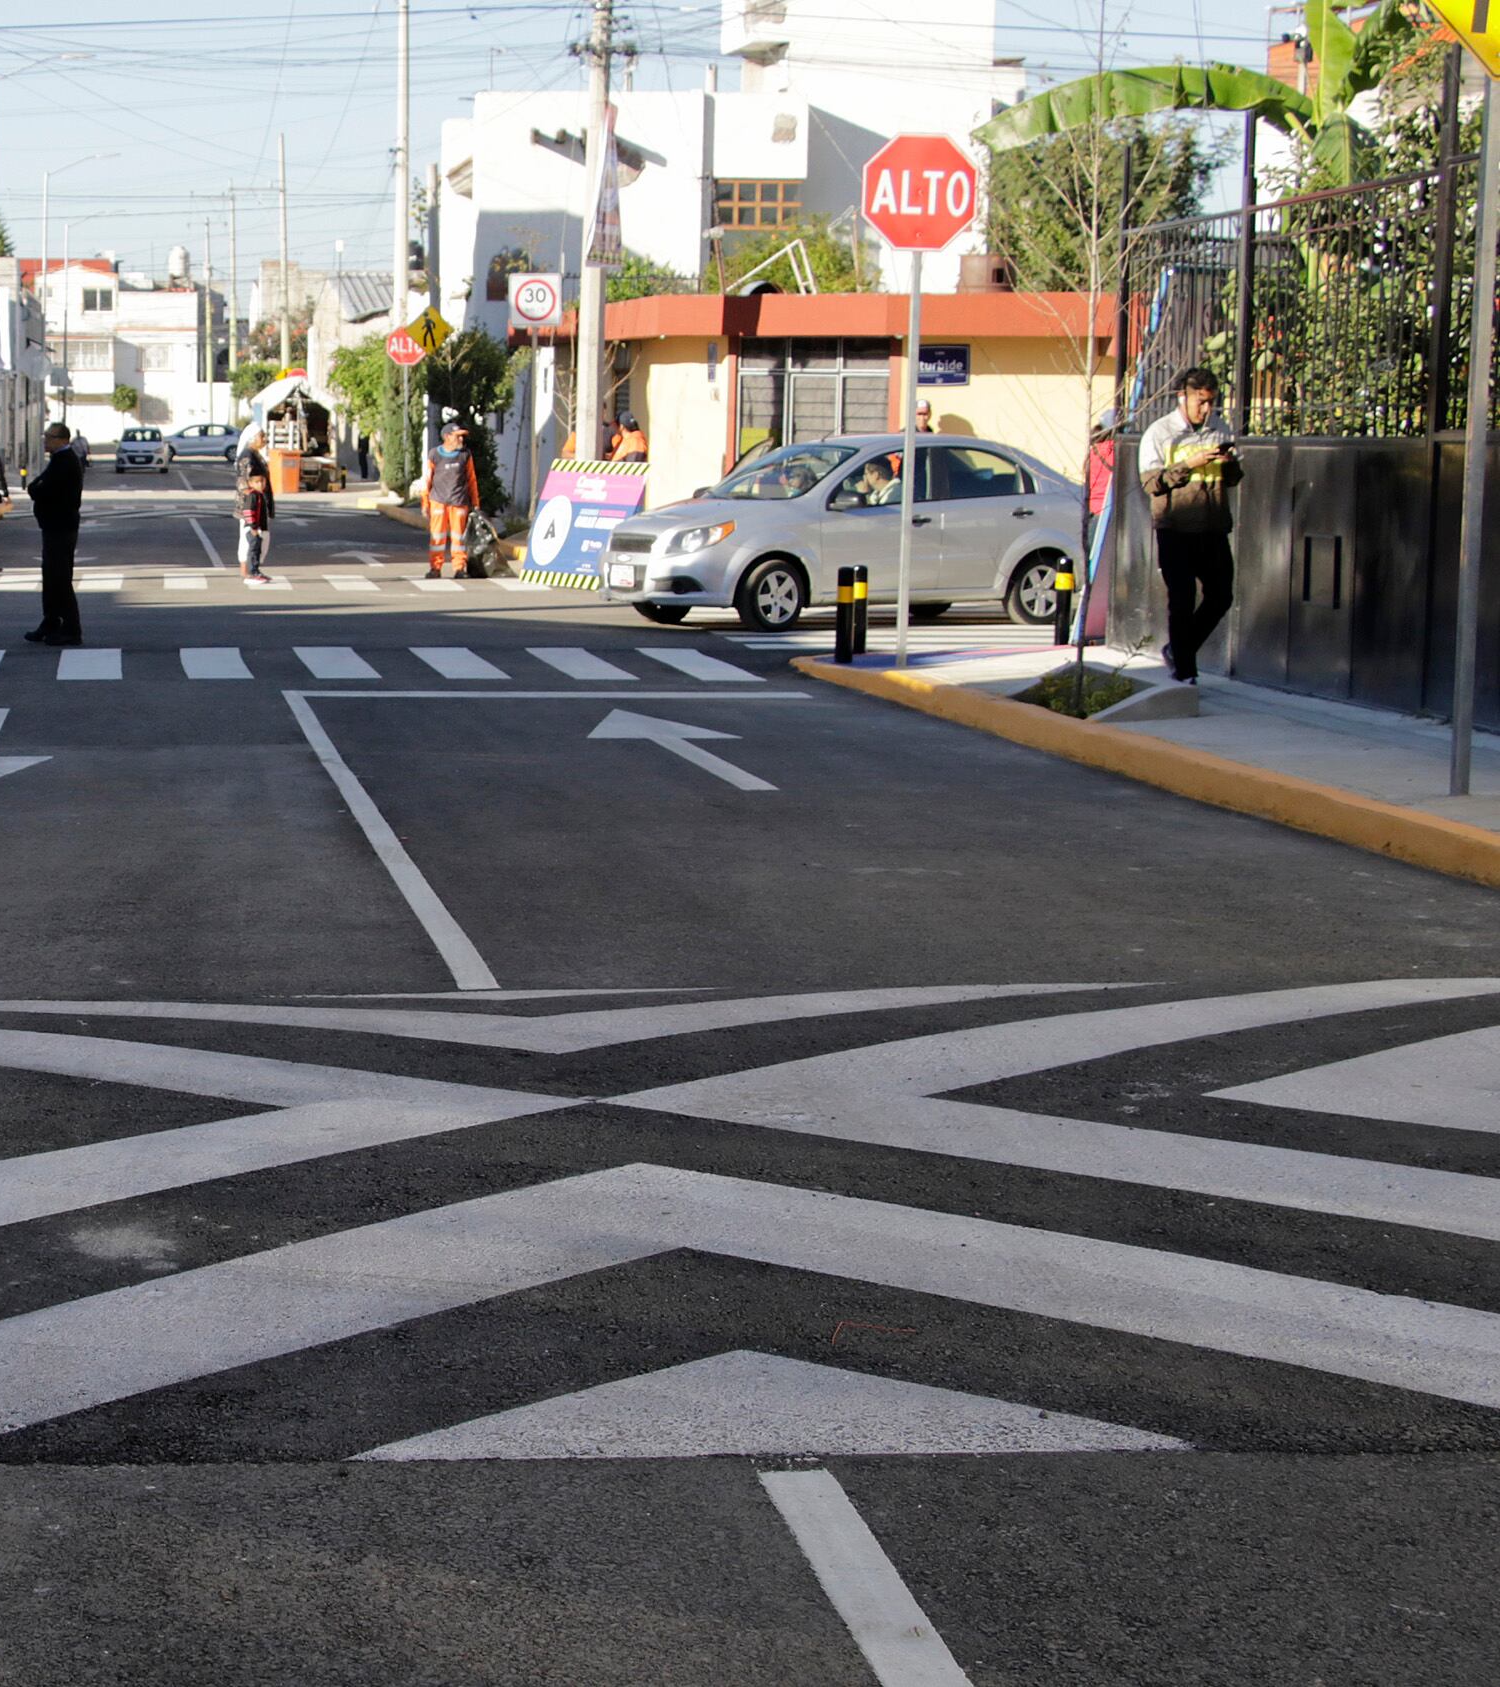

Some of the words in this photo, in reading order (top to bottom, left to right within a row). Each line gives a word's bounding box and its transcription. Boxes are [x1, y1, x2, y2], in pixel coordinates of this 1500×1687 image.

[870, 168, 970, 218] ALTO
[524, 287, 547, 304] 30
[919, 359, 964, 371] turbide
